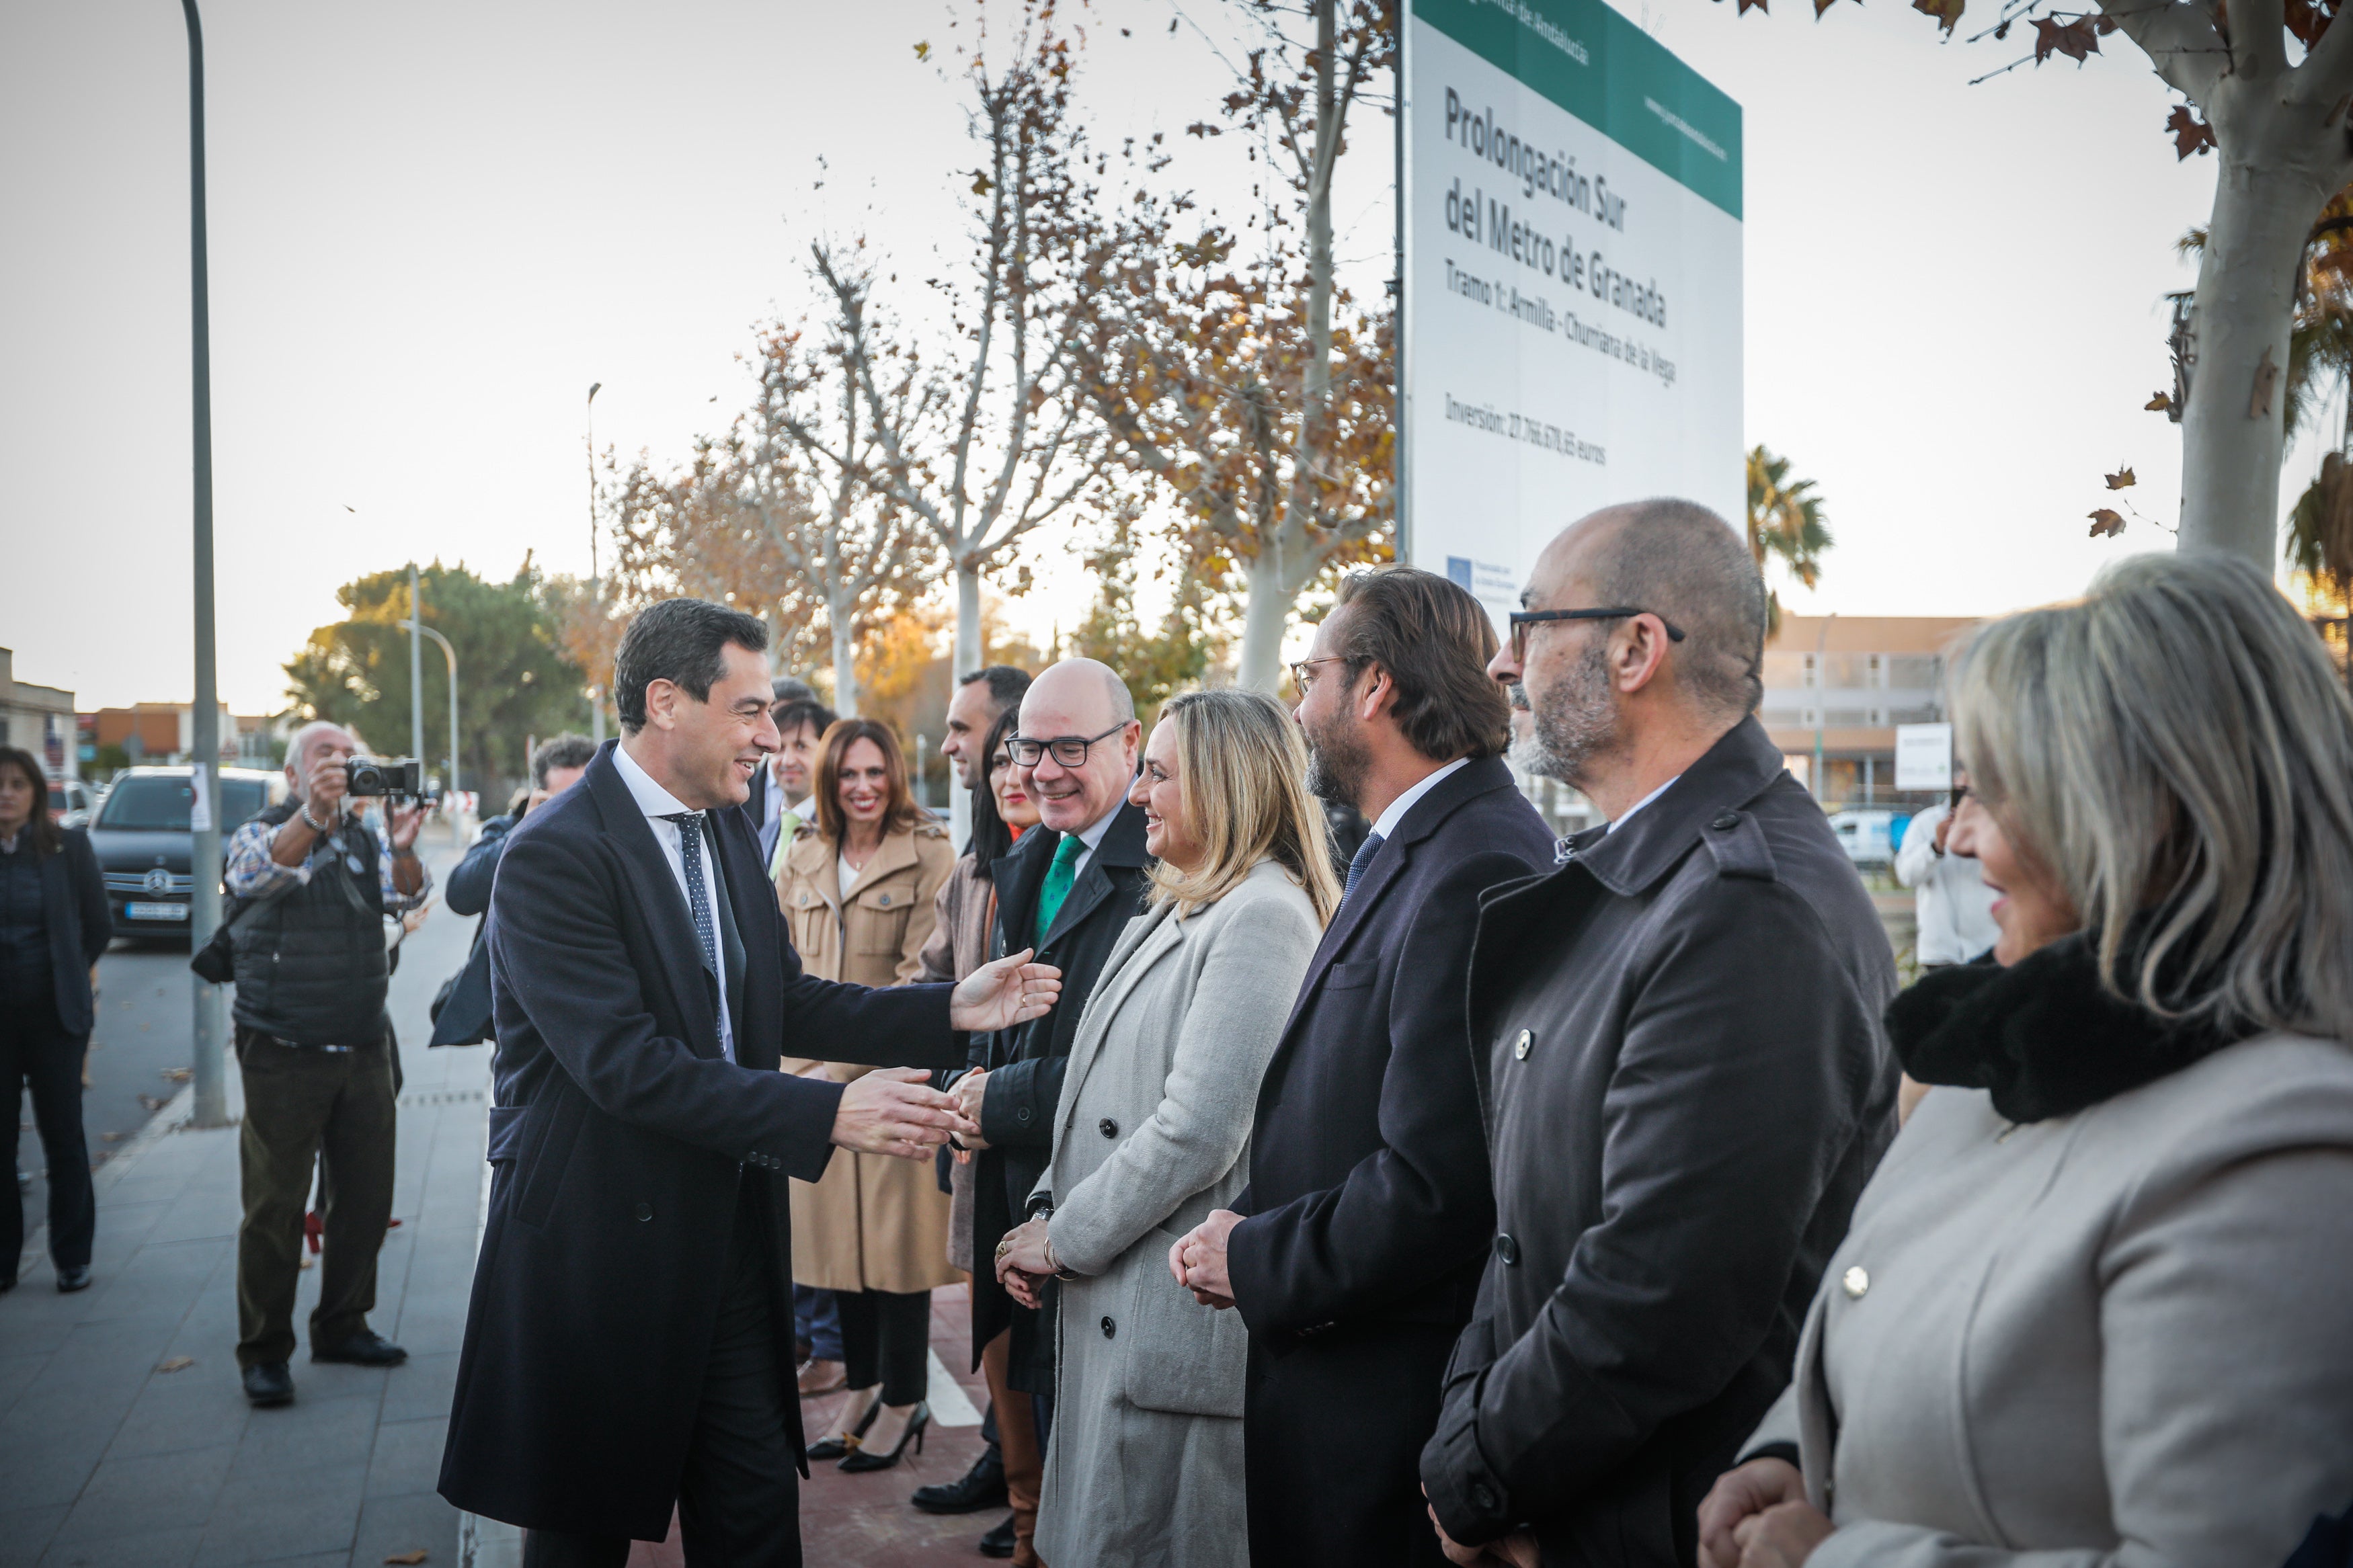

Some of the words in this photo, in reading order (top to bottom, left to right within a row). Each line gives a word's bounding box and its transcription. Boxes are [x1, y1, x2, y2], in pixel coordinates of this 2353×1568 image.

[1445, 85, 1590, 214] Prolongación
[1595, 174, 1626, 233] Sur
[1447, 176, 1482, 243] del
[1488, 197, 1554, 276] Metro
[1560, 234, 1585, 290] de
[1589, 250, 1666, 329] Granada
[1445, 257, 1492, 306] Tramo
[1494, 280, 1507, 313] 1:
[1509, 286, 1555, 333] Armilla
[1564, 311, 1622, 360] Churriana
[1624, 335, 1637, 366] de
[1638, 340, 1649, 371] la
[1650, 346, 1676, 388] Vega
[1445, 391, 1507, 437] Inversión:
[1578, 440, 1606, 466] euros
